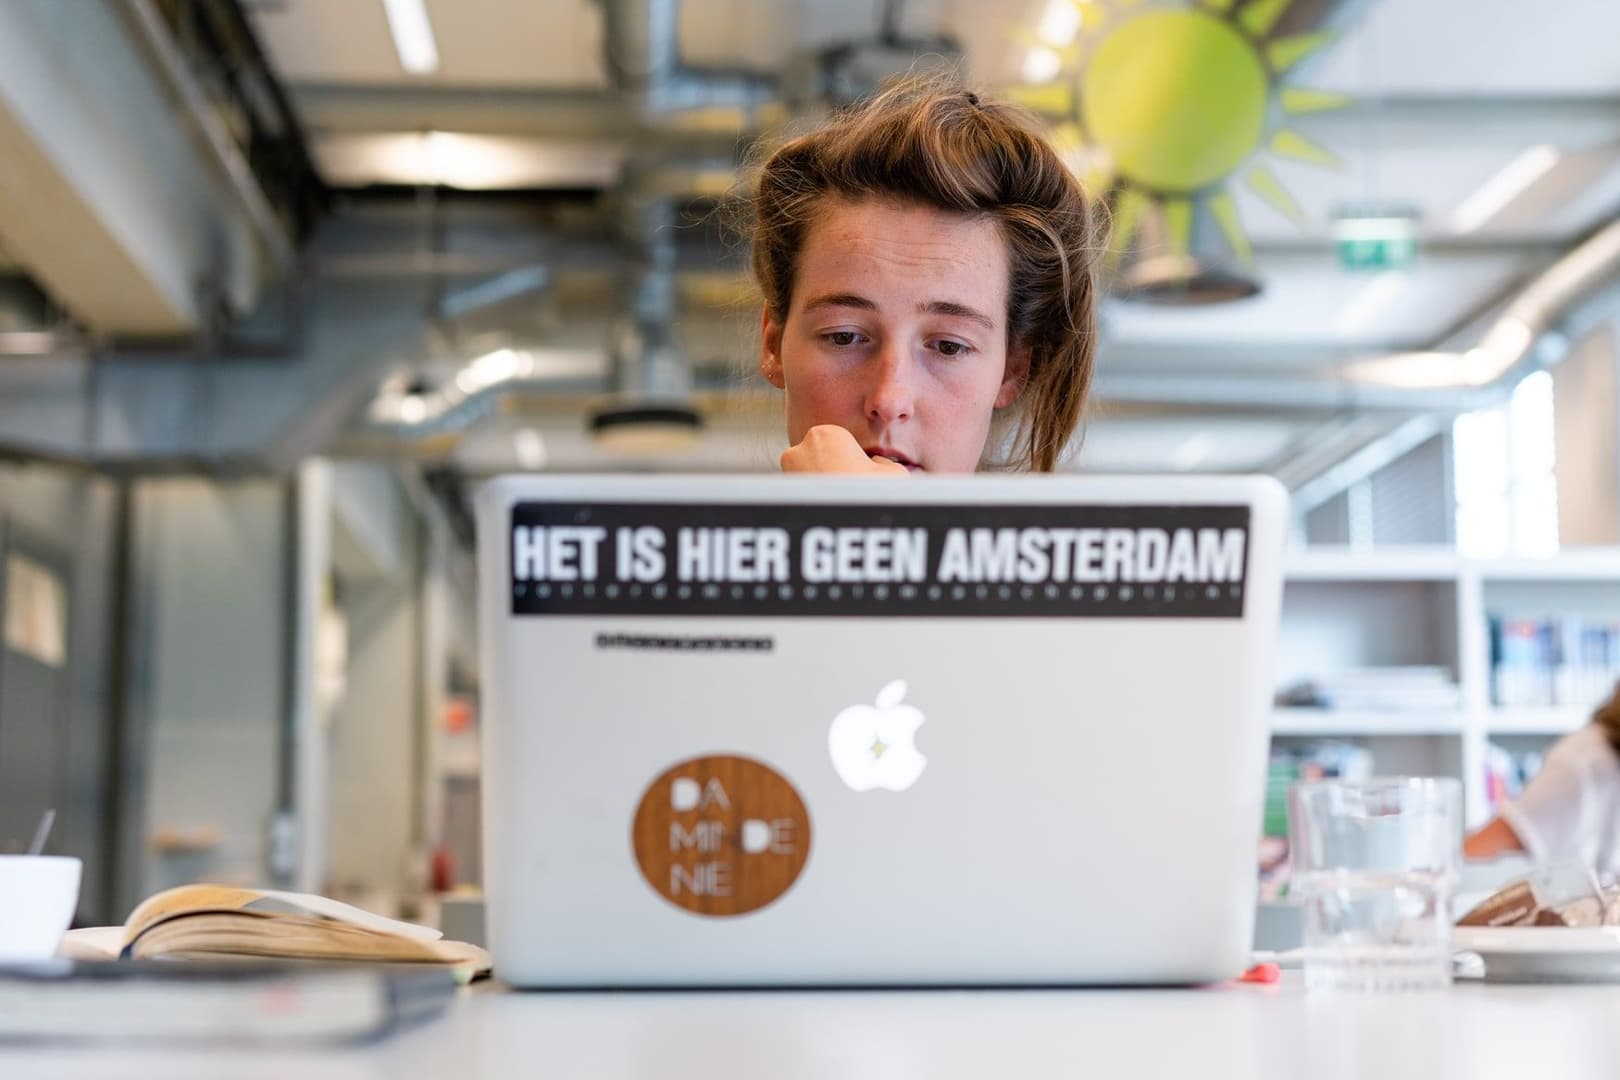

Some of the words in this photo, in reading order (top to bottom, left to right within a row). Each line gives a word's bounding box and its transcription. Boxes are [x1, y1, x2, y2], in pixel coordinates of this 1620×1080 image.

[514, 526, 606, 581] HET
[616, 526, 666, 582] IS
[678, 527, 789, 583] HIER
[802, 527, 927, 583] GEEN
[938, 527, 1246, 583] AMSTERDAM
[671, 777, 731, 812] DA
[670, 862, 733, 897] NIE
